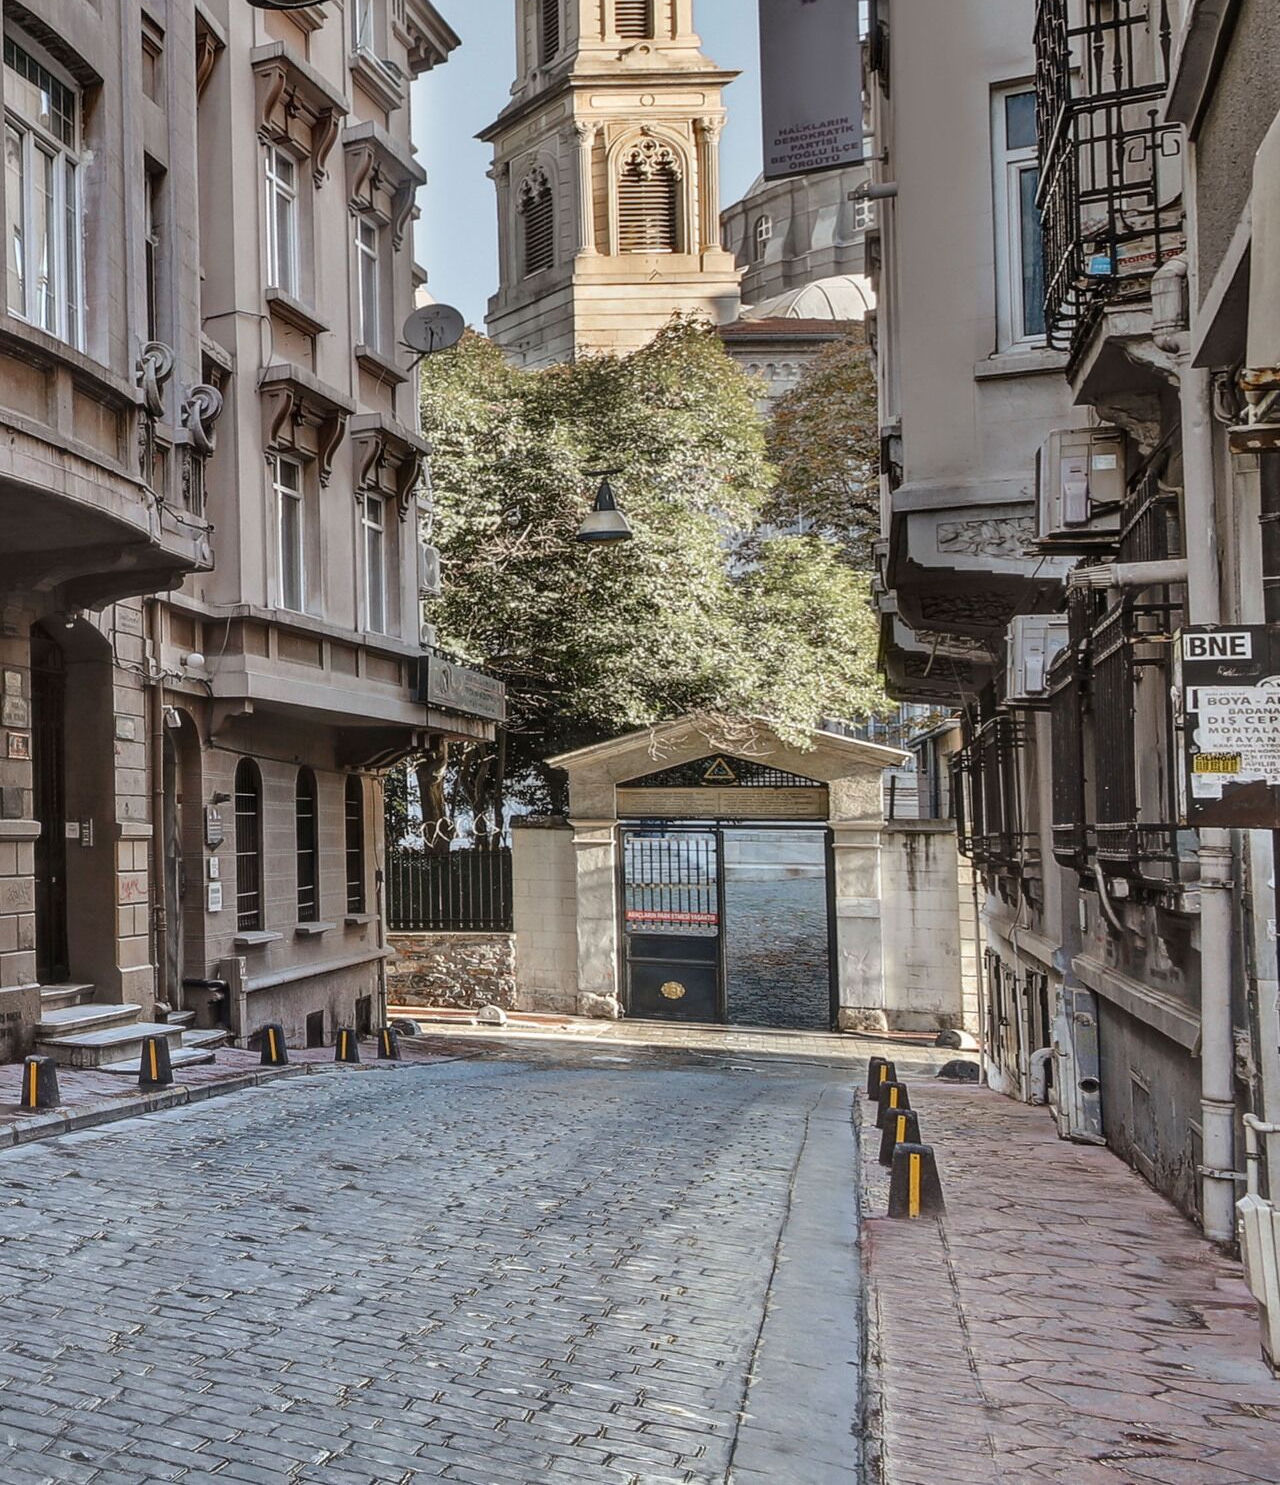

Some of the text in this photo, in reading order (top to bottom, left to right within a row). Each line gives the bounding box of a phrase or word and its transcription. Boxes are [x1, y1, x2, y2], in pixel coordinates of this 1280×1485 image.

[778, 117, 849, 136] HALKLARIN
[774, 124, 854, 146] DEMOKRATİK
[790, 136, 838, 152] PARTİSİ
[771, 148, 827, 164] BEYOĞLU
[1189, 635, 1247, 657] BNE
[1207, 697, 1252, 705] BOYA
[1208, 716, 1237, 726] DIŞ
